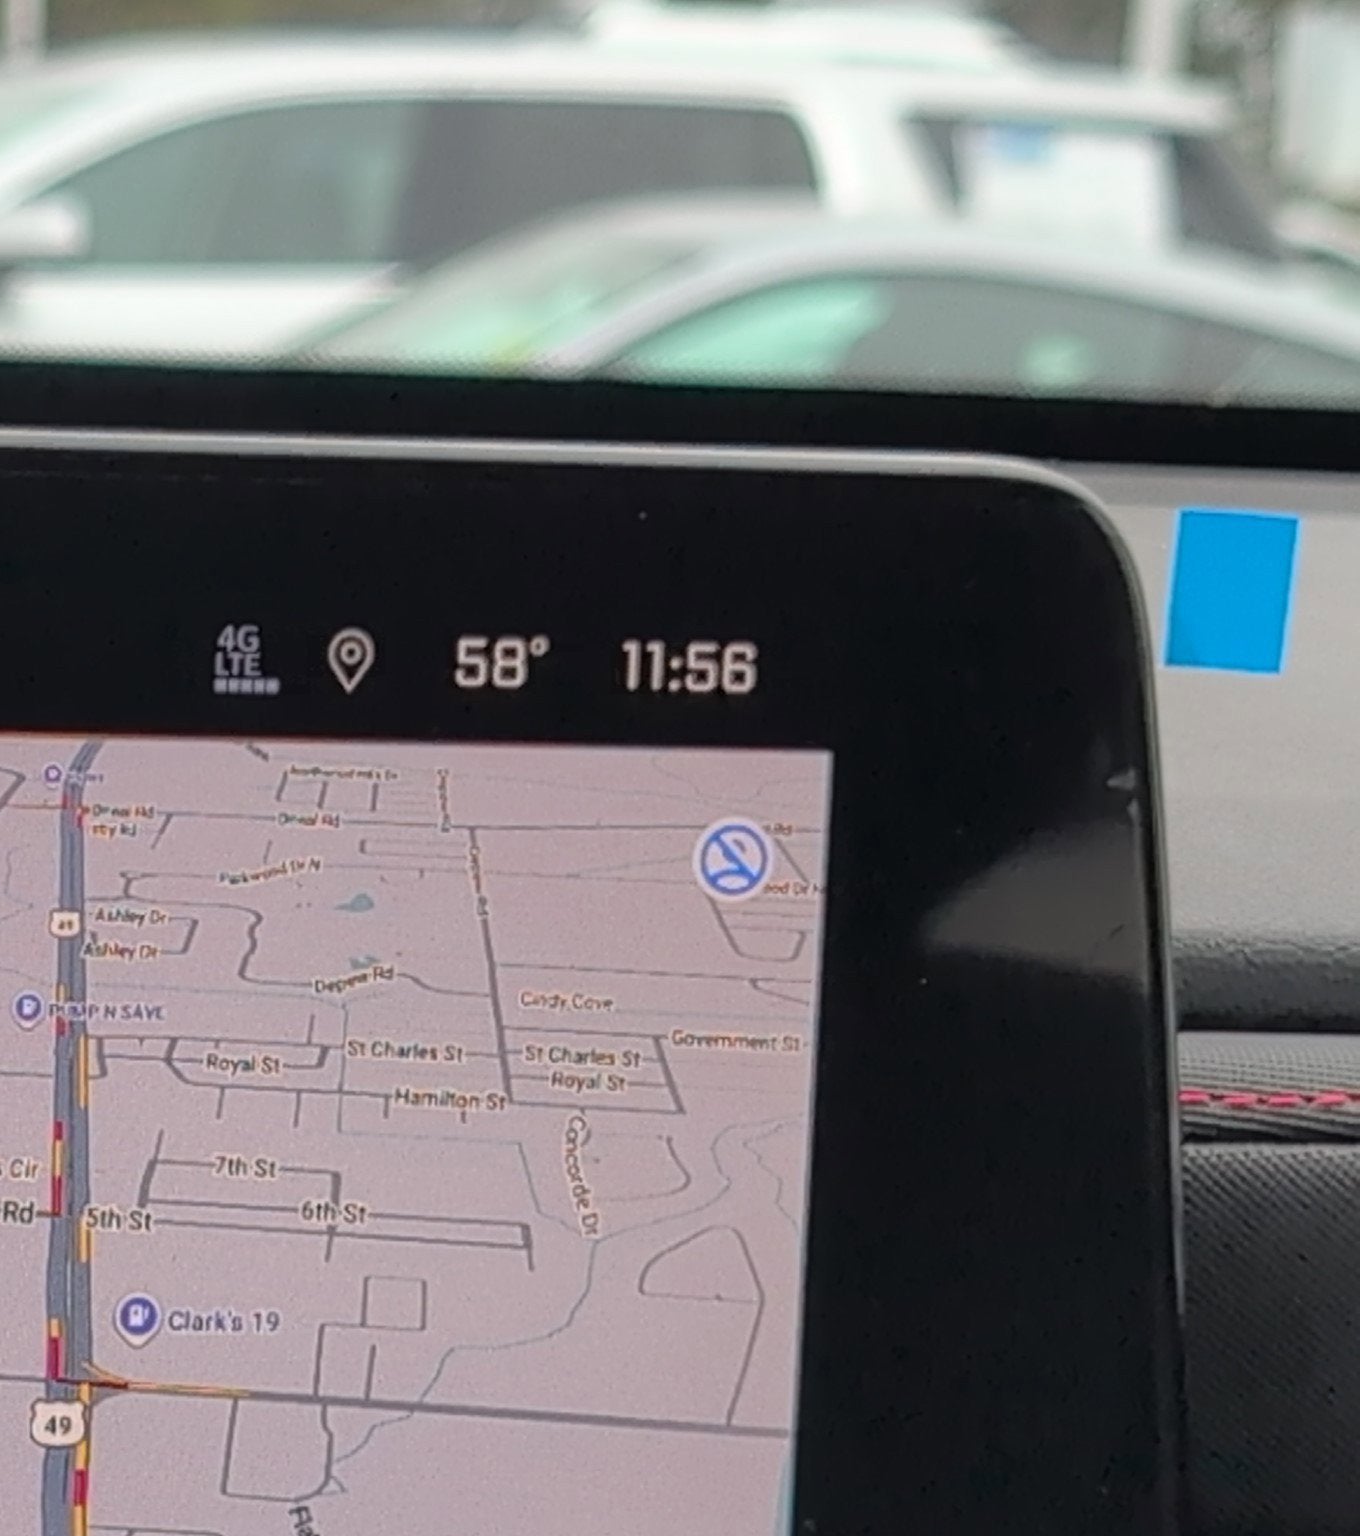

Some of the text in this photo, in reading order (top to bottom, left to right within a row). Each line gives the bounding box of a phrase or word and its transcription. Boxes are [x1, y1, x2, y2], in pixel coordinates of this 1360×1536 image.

[217, 625, 260, 652] 4G
[215, 653, 262, 676] LTE
[622, 639, 758, 694] 11:56
[95, 907, 167, 928] Ashley Dr
[139, 944, 159, 960] Dr
[372, 963, 395, 982] Rd
[347, 1040, 463, 1063] St Charles St
[671, 1029, 801, 1052] Government St
[206, 1052, 281, 1075] Royal St
[525, 1044, 641, 1068] St Charles St
[551, 1072, 626, 1094] Royal St
[394, 1088, 507, 1111] Hamilton St
[9, 1157, 40, 1179] Cir
[214, 1156, 278, 1178] 7th St
[2, 1200, 35, 1224] Rd
[86, 1206, 152, 1232] 5th St
[301, 1201, 368, 1223] 6th St
[581, 1212, 599, 1236] Dr
[168, 1309, 280, 1332] Clark's 19
[44, 1415, 72, 1434] 49
